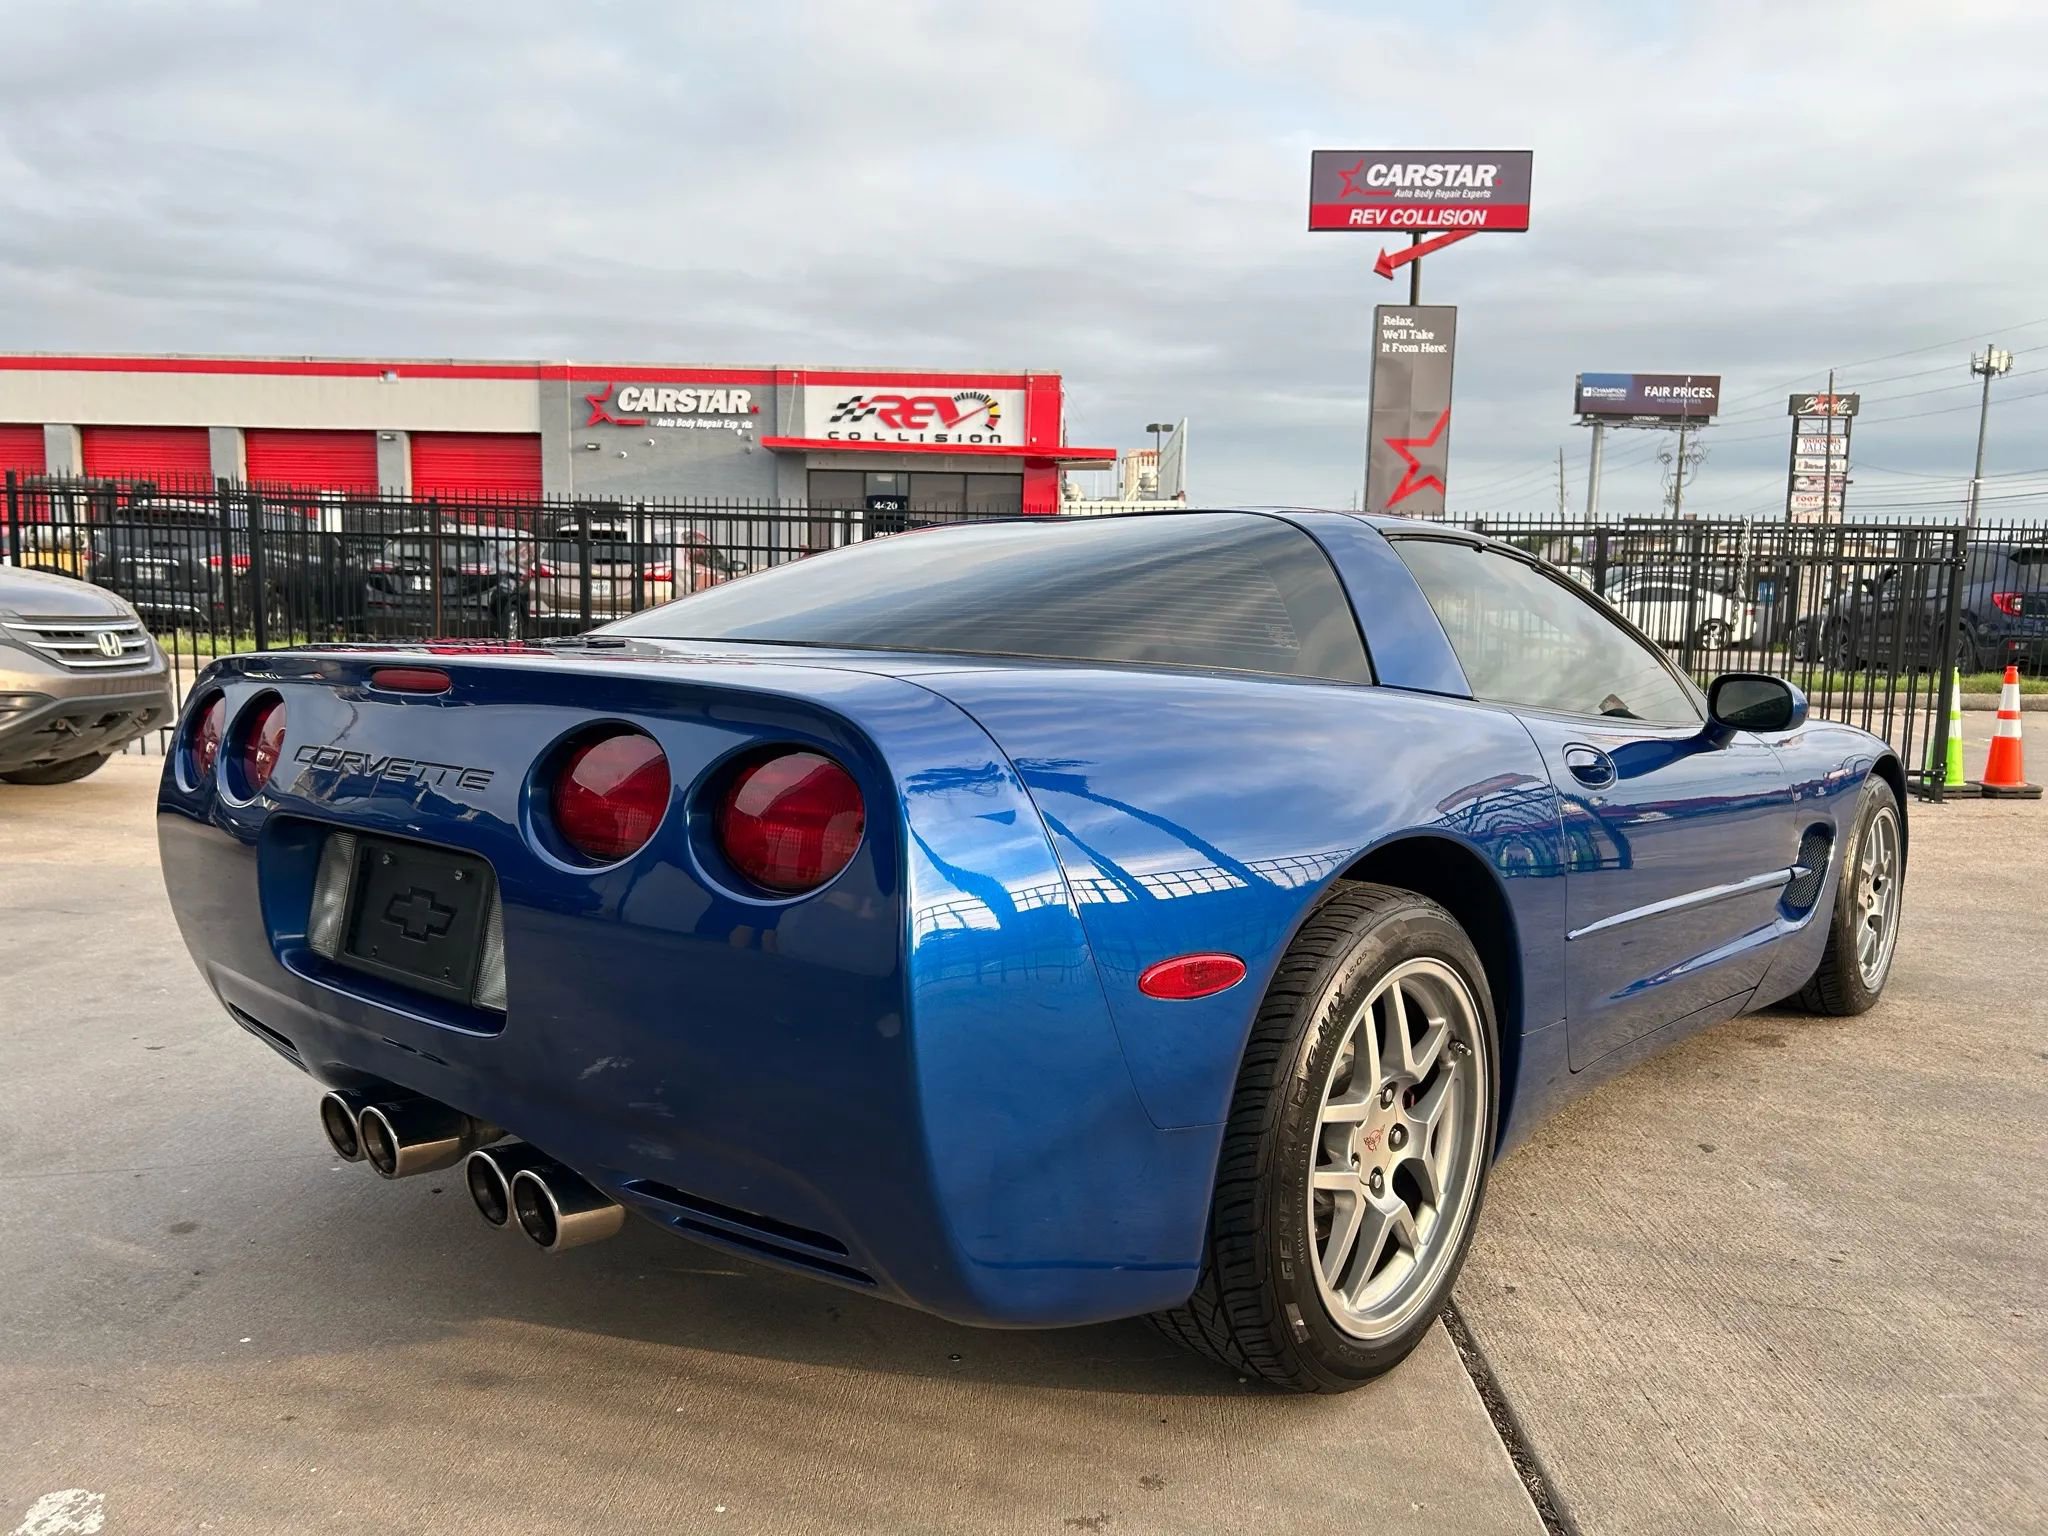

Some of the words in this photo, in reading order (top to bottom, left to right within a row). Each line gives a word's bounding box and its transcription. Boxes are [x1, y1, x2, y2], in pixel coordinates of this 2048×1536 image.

[1366, 164, 1497, 187] CARSTAR
[1394, 189, 1412, 198] Auto
[1414, 189, 1434, 199] Body
[1435, 189, 1461, 199] Repair
[1462, 189, 1491, 199] Experts
[1349, 209, 1387, 224] REV
[1390, 209, 1487, 225] COLLISION
[1383, 315, 1414, 327] Relax,
[1382, 329, 1407, 339] We'll
[1409, 329, 1434, 339] Take
[1382, 343, 1390, 352] It
[1391, 343, 1419, 352] From
[1644, 386, 1670, 397] FAIR
[1673, 386, 1715, 398] PRICES.
[617, 386, 751, 413] CARSTAR
[859, 395, 968, 430] REV
[657, 418, 675, 427] Auto
[676, 418, 696, 429] Body
[697, 419, 722, 430] Repair
[828, 431, 1002, 443] COLLISION
[294, 745, 494, 791] CORVETTE
